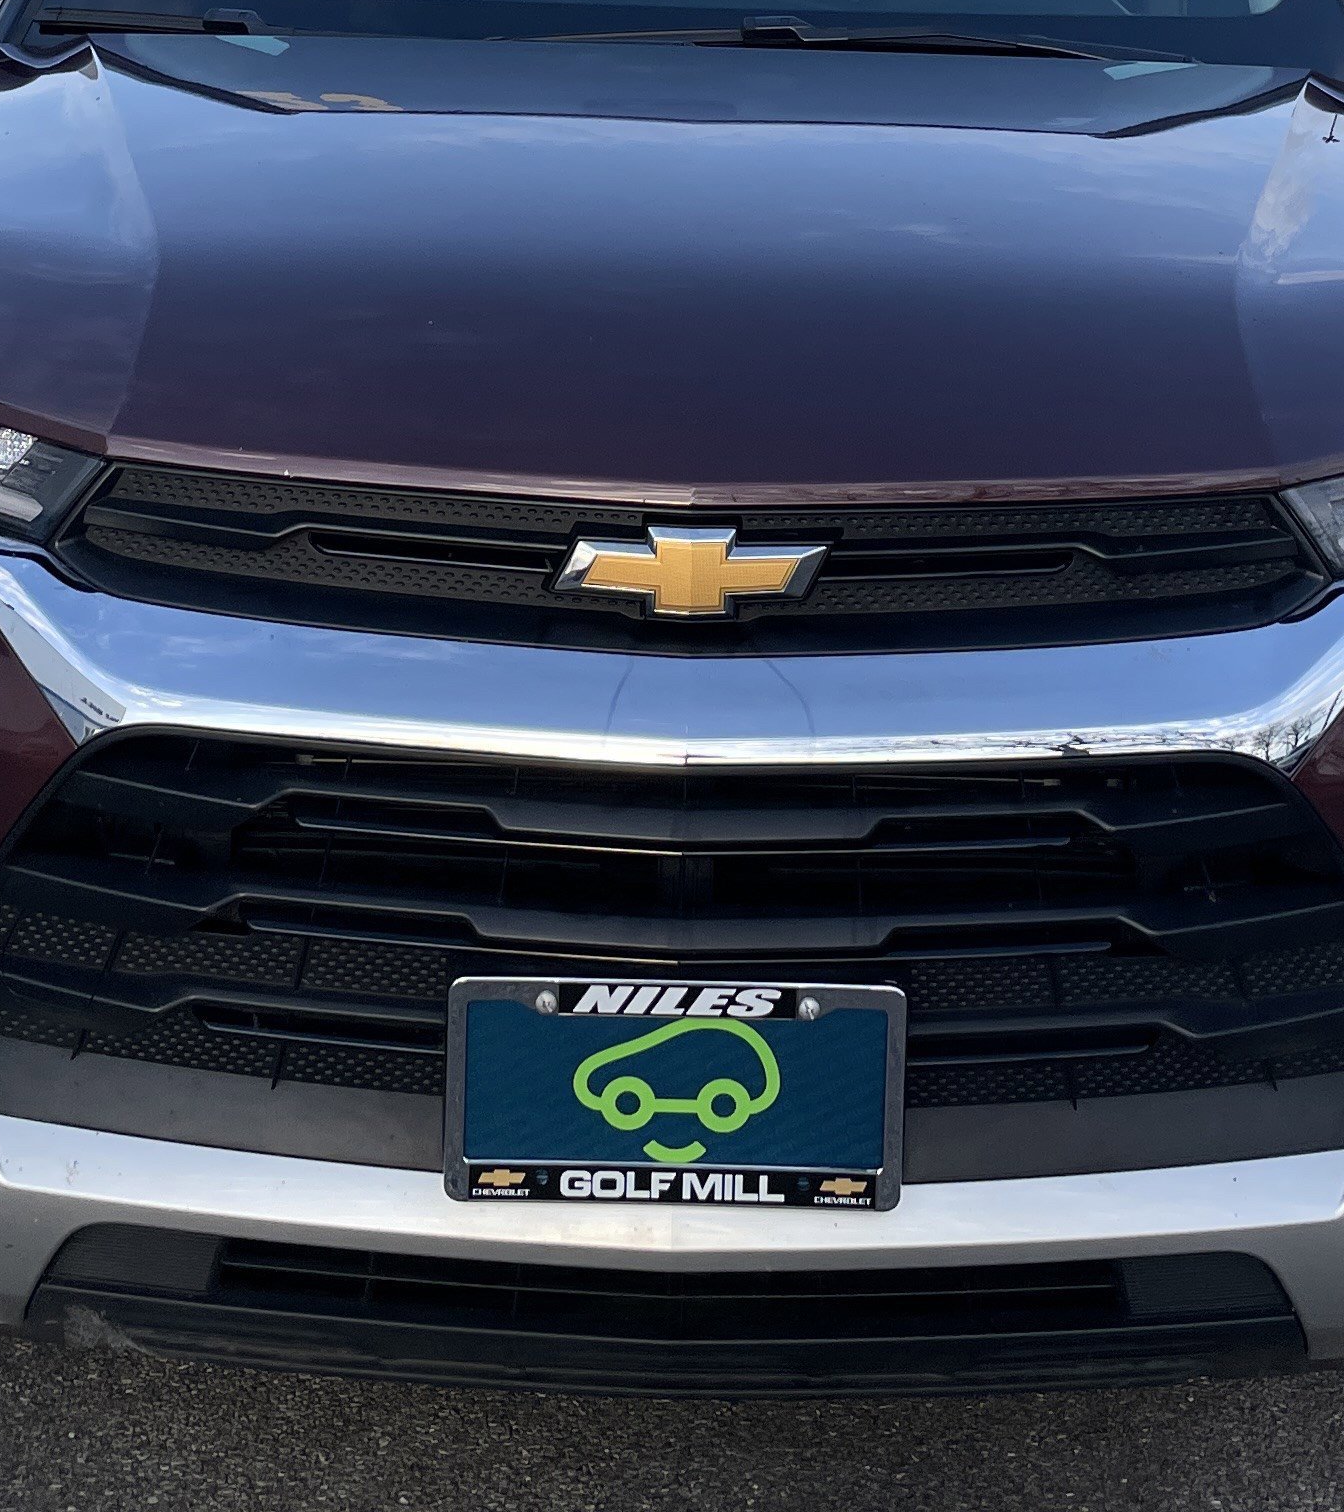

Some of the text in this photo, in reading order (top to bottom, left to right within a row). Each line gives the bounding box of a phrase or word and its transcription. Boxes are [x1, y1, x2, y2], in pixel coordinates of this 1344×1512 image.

[572, 984, 782, 1018] NILES
[472, 1187, 531, 1197] CHEVROLET
[559, 1169, 785, 1203] GOLF MILL
[813, 1195, 871, 1206] CHEVROLET
